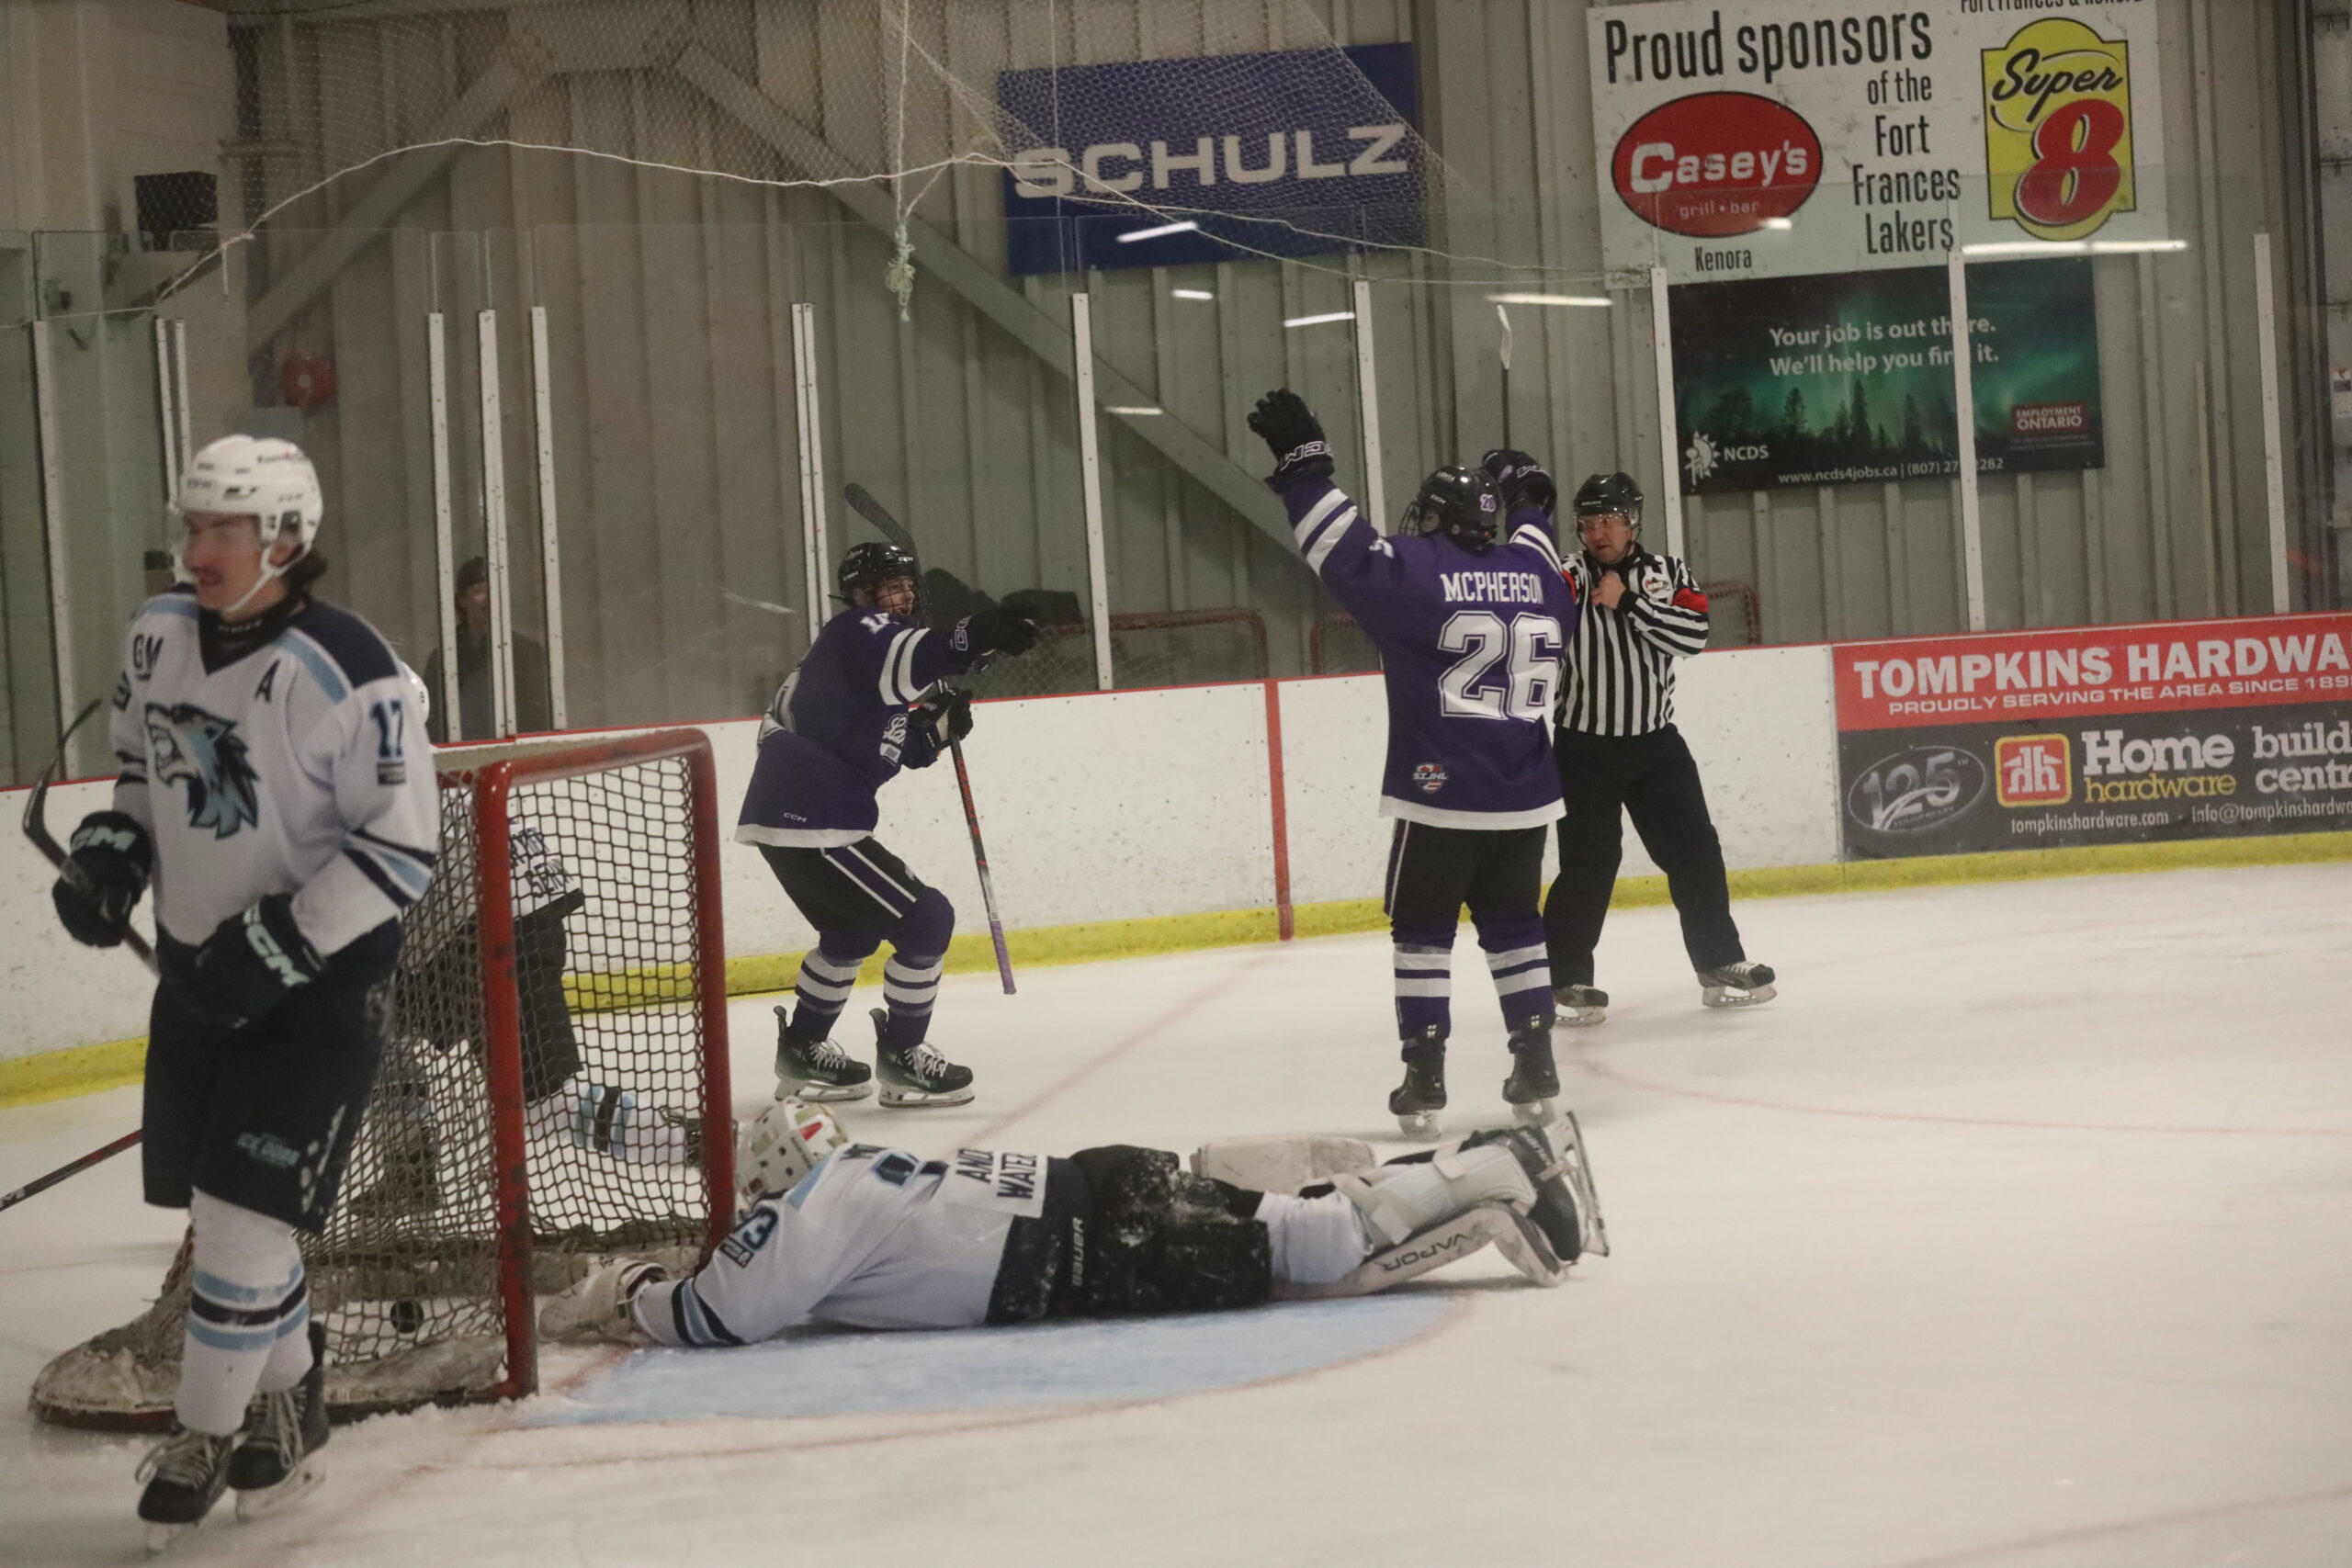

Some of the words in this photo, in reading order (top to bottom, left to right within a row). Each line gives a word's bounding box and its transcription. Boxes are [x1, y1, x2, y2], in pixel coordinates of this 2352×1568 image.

[1605, 11, 1724, 84] Proud
[1737, 12, 1932, 84] sponsors
[1868, 70, 1889, 105] of
[1895, 68, 1932, 103] the
[1992, 49, 2123, 123] Super
[1875, 115, 1929, 156] Fort
[1013, 124, 1408, 198] SCHULZ
[1631, 140, 1807, 193] Casey's
[2013, 98, 2125, 227] 8
[1852, 164, 1961, 206] Frances
[1679, 200, 1715, 220] grill
[1731, 200, 1760, 213] bar
[1865, 210, 1954, 254] Lakers
[1695, 247, 1752, 272] Kenora
[1770, 328, 1820, 346] Your
[1824, 323, 1860, 347] job
[1866, 322, 1883, 340] is
[1889, 320, 1926, 338] out
[1931, 316, 1996, 336] thre.
[1770, 355, 1823, 376] We'll
[1829, 352, 1877, 375] help
[1883, 352, 1923, 373] you
[1928, 345, 1957, 366] fin
[1976, 344, 1999, 362] it.
[2016, 406, 2081, 418] EMPLOYMENT
[2017, 415, 2082, 430] ONTARIO
[1723, 445, 1770, 463] NCDS
[1779, 465, 1897, 483] www.ncds4jobs.ca
[1907, 461, 1940, 478] (807)
[1440, 571, 1544, 604] MCPHERSON
[254, 656, 280, 703] A
[1437, 611, 1562, 723] 26
[1853, 647, 2113, 699] TOMPKINS
[2127, 633, 2352, 682] HARDWA
[1888, 695, 1997, 716] PROUDLY
[2003, 689, 2105, 708] SERVING
[2109, 685, 2154, 702] THE
[2159, 682, 2223, 699] AREA
[2229, 679, 2299, 694] SINCE
[2304, 675, 2352, 689] 189
[2081, 729, 2234, 775] Home
[1863, 751, 1961, 830] 125
[2084, 773, 2236, 804] hardware
[783, 811, 808, 824] CCM
[2011, 809, 2169, 837] tompkinshardware.com
[956, 1148, 994, 1184] AND
[1382, 1233, 1471, 1272] VAPOR
